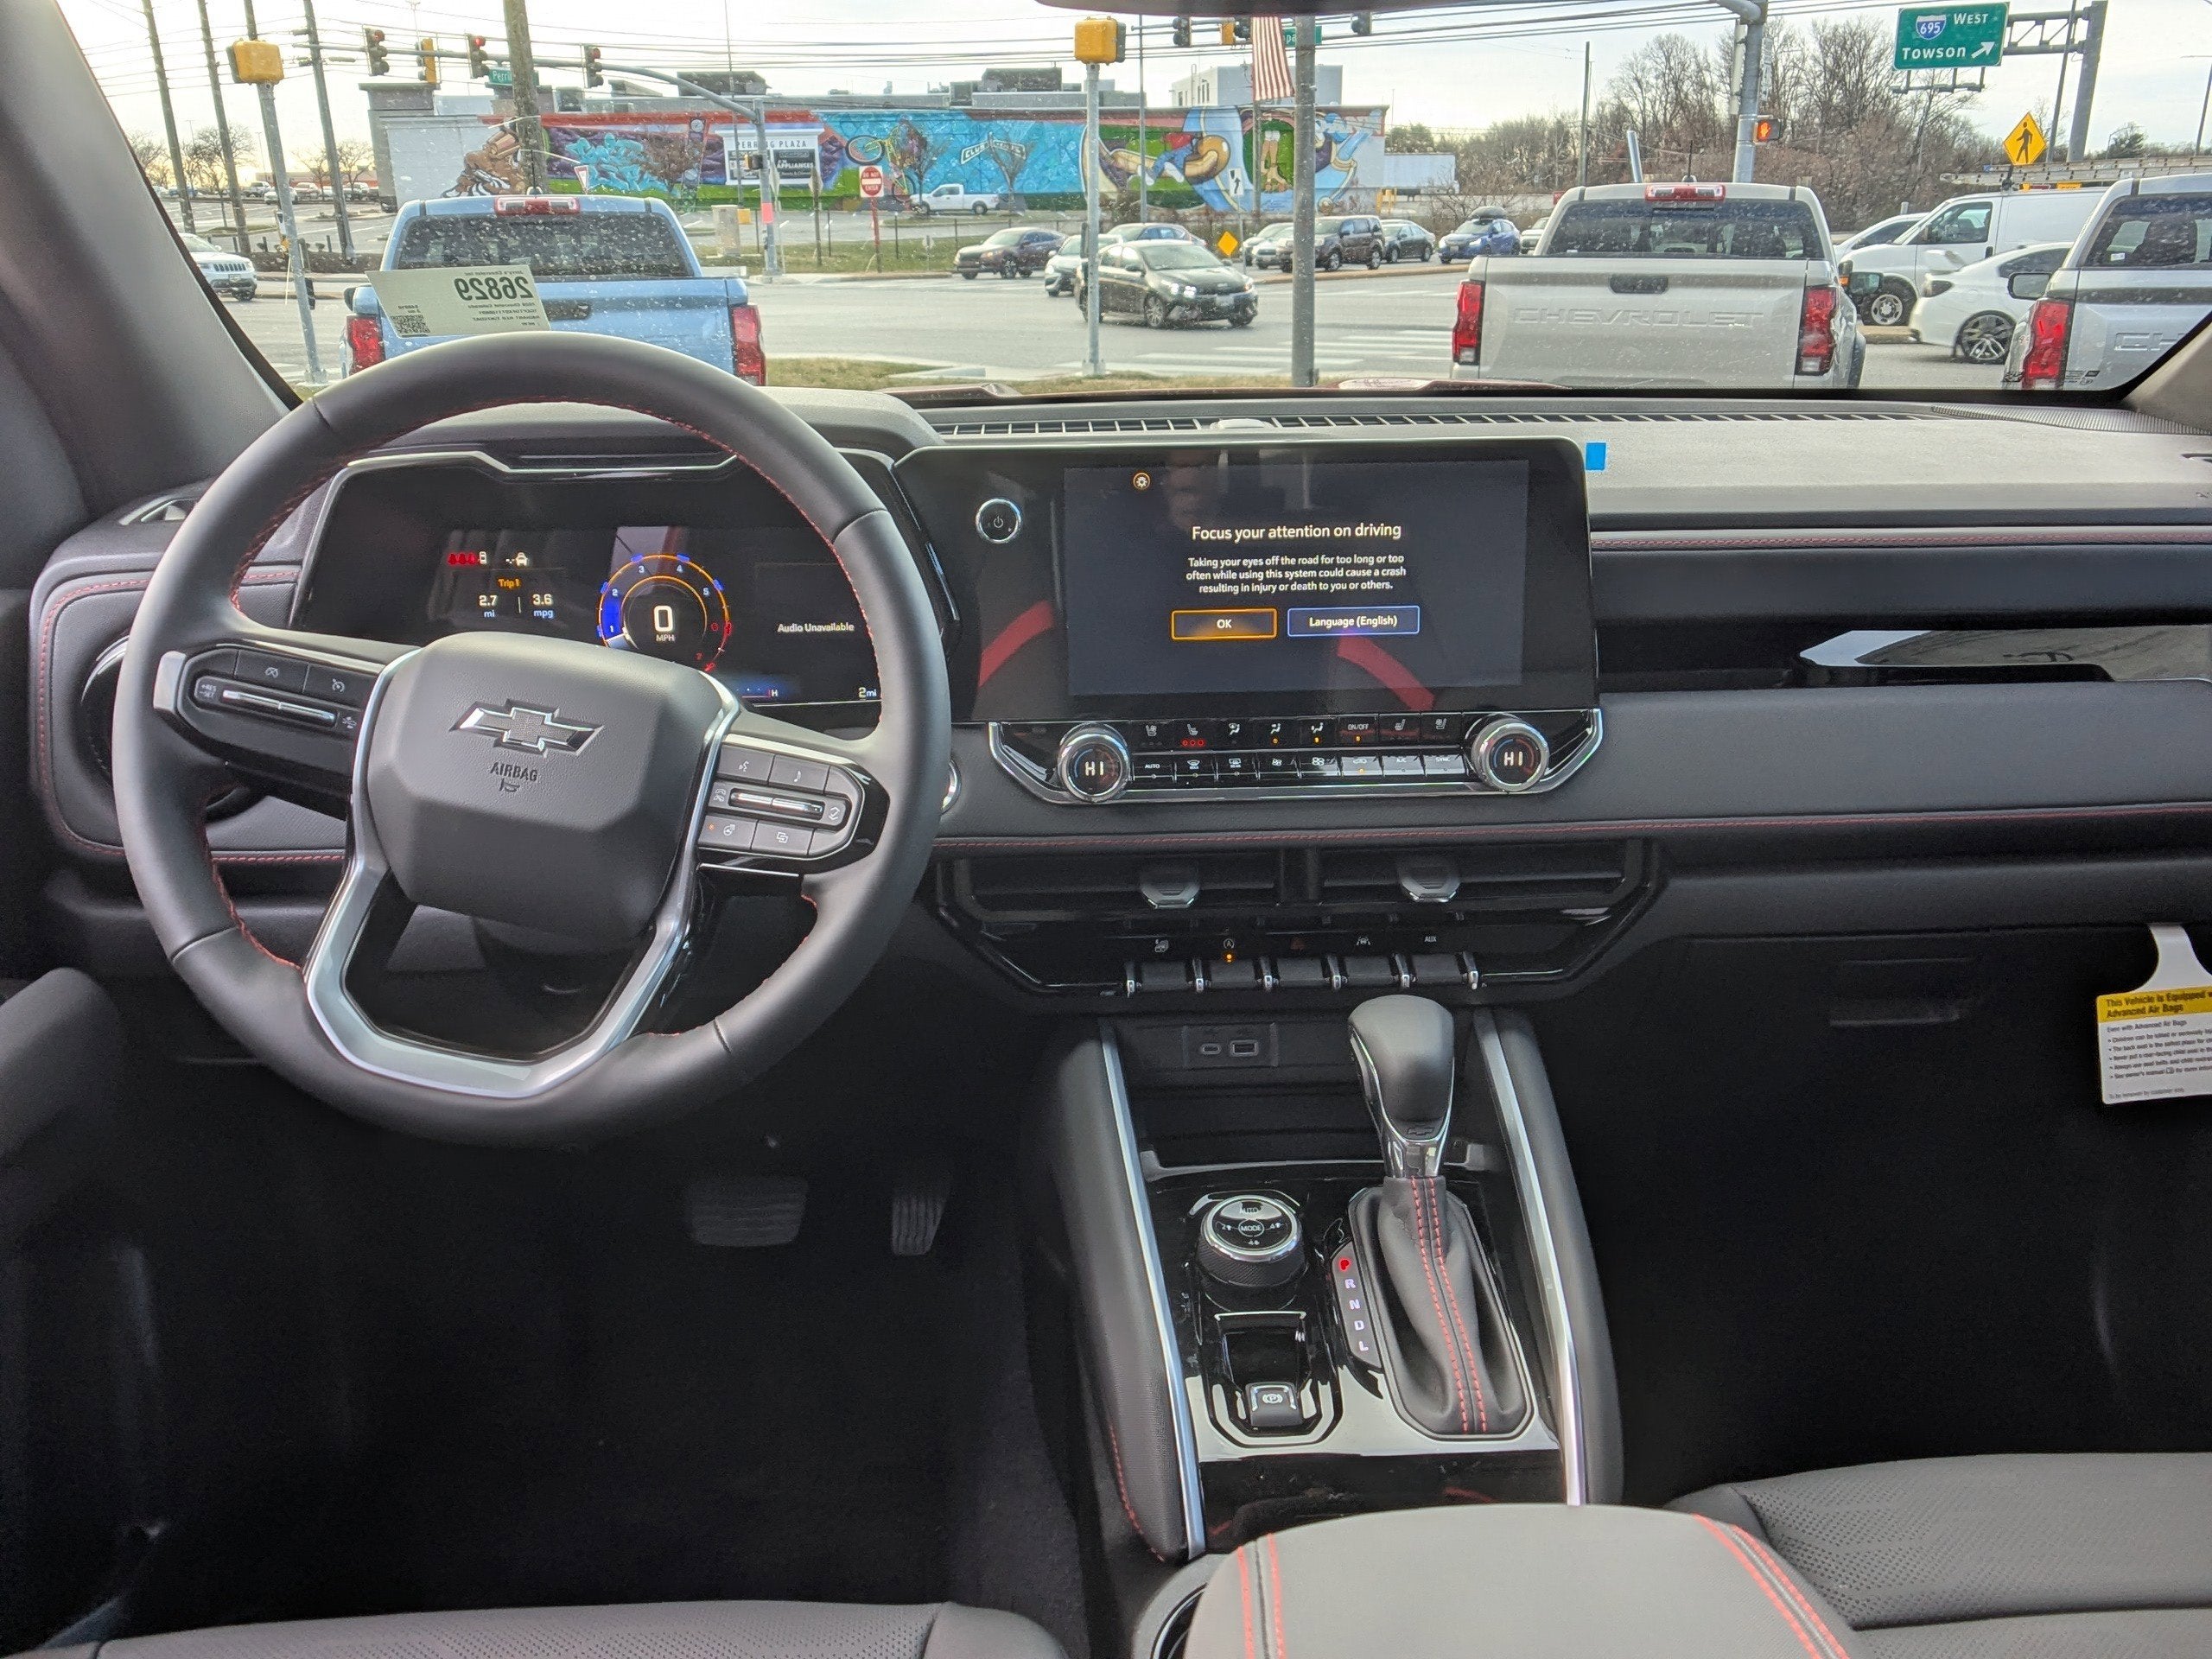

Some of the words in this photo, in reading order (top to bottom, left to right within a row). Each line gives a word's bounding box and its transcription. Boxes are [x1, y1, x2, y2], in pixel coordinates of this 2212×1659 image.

[1920, 22, 1941, 34] 695
[1954, 13, 1988, 24] WEST
[493, 70, 512, 82] Perri
[1514, 308, 1764, 327] CHEVROLET
[1192, 526, 1232, 540] Focus
[1234, 527, 1265, 543] your
[1268, 525, 1331, 538] attention
[1333, 527, 1351, 537] on
[1355, 523, 1402, 539] driving
[1188, 557, 1218, 569] Taking
[1219, 559, 1240, 569] your
[1242, 558, 1263, 568] eyes
[1265, 555, 1280, 566] off
[1281, 555, 1296, 565] the
[1298, 555, 1319, 565] road
[1320, 554, 1334, 564] for
[1336, 555, 1352, 564] too
[1353, 554, 1374, 566] long
[1376, 556, 1387, 564] or
[1388, 554, 1405, 563] too
[676, 565, 683, 574] 4
[1185, 570, 1211, 581] often
[1212, 569, 1237, 580] while
[1239, 570, 1264, 582] using
[1265, 569, 1283, 579] this
[1284, 569, 1317, 581] system
[1319, 568, 1344, 578] could
[1345, 568, 1372, 577] cause
[1381, 566, 1407, 576] crash
[498, 578, 516, 588] Trip
[1198, 582, 1239, 594] resulting
[1241, 582, 1250, 593] in
[1251, 582, 1277, 594] injury
[1278, 583, 1289, 592] or
[1290, 582, 1318, 592] death
[1319, 582, 1329, 591] to
[1330, 582, 1348, 594] you
[1349, 582, 1359, 590] or
[1360, 580, 1394, 590] others.
[612, 588, 619, 597] 2
[479, 594, 498, 607] 2.7
[532, 594, 553, 606] 3.6
[484, 609, 495, 618] mi
[533, 609, 554, 620] mpg
[653, 605, 674, 632] 0
[778, 623, 804, 632] Audio
[804, 622, 855, 632] Unavailable
[1217, 619, 1232, 629] OK
[1309, 616, 1355, 628] Language
[1356, 614, 1398, 629] (English)
[858, 687, 867, 699] 2
[1347, 722, 1370, 731] ON/OFF
[1504, 751, 1523, 766] HI
[490, 762, 537, 782] AIRBAG
[1084, 761, 1104, 776] HI
[2125, 996, 2154, 1005] Vehicle
[2107, 1007, 2145, 1017] Advanced
[1340, 1259, 1350, 1271] P
[1344, 1279, 1356, 1289] R
[1349, 1299, 1361, 1310] N
[1354, 1319, 1365, 1331] D
[1358, 1340, 1369, 1351] L
